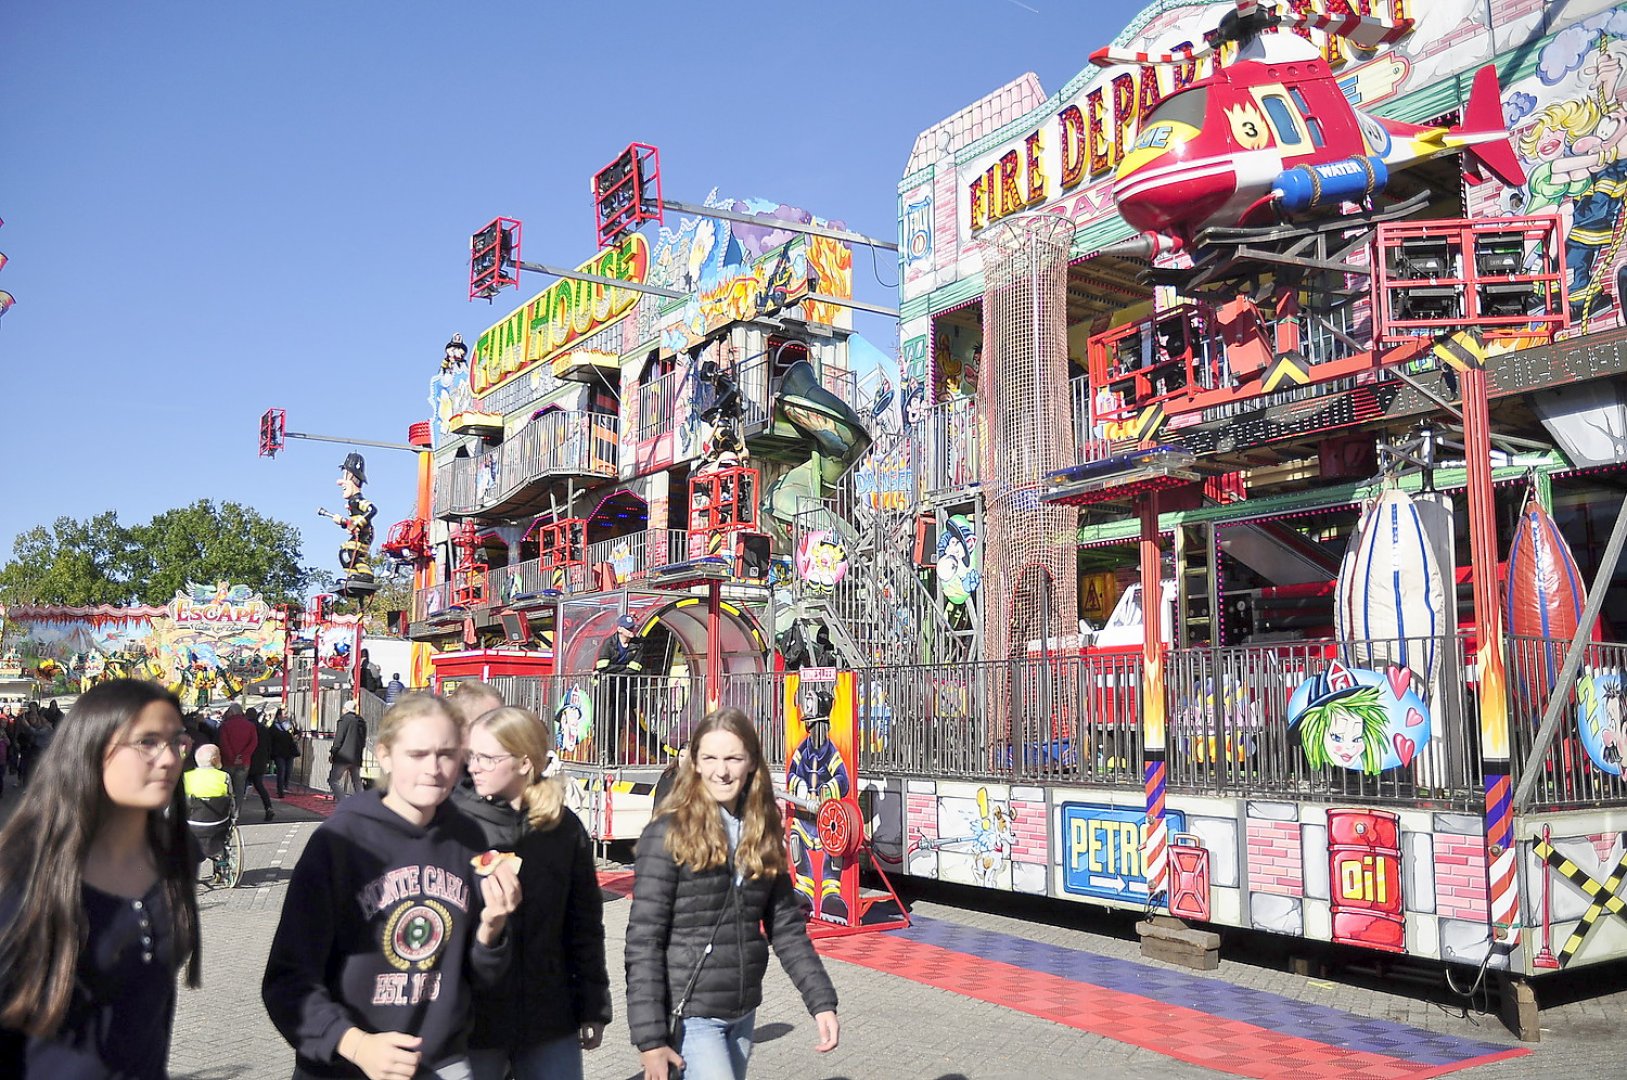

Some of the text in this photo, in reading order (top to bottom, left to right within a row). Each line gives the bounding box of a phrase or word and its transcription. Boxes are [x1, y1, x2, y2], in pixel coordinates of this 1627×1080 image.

[1242, 121, 1258, 138] 3
[969, 128, 1047, 231] FIRE
[1316, 160, 1364, 179] WATER
[475, 235, 638, 393] FUN HOUSE
[177, 600, 260, 623] ESCAPE
[1070, 817, 1168, 878] PETR
[358, 865, 421, 920] MONTE
[1341, 856, 1387, 904] Oil
[373, 973, 408, 1004] EST.
